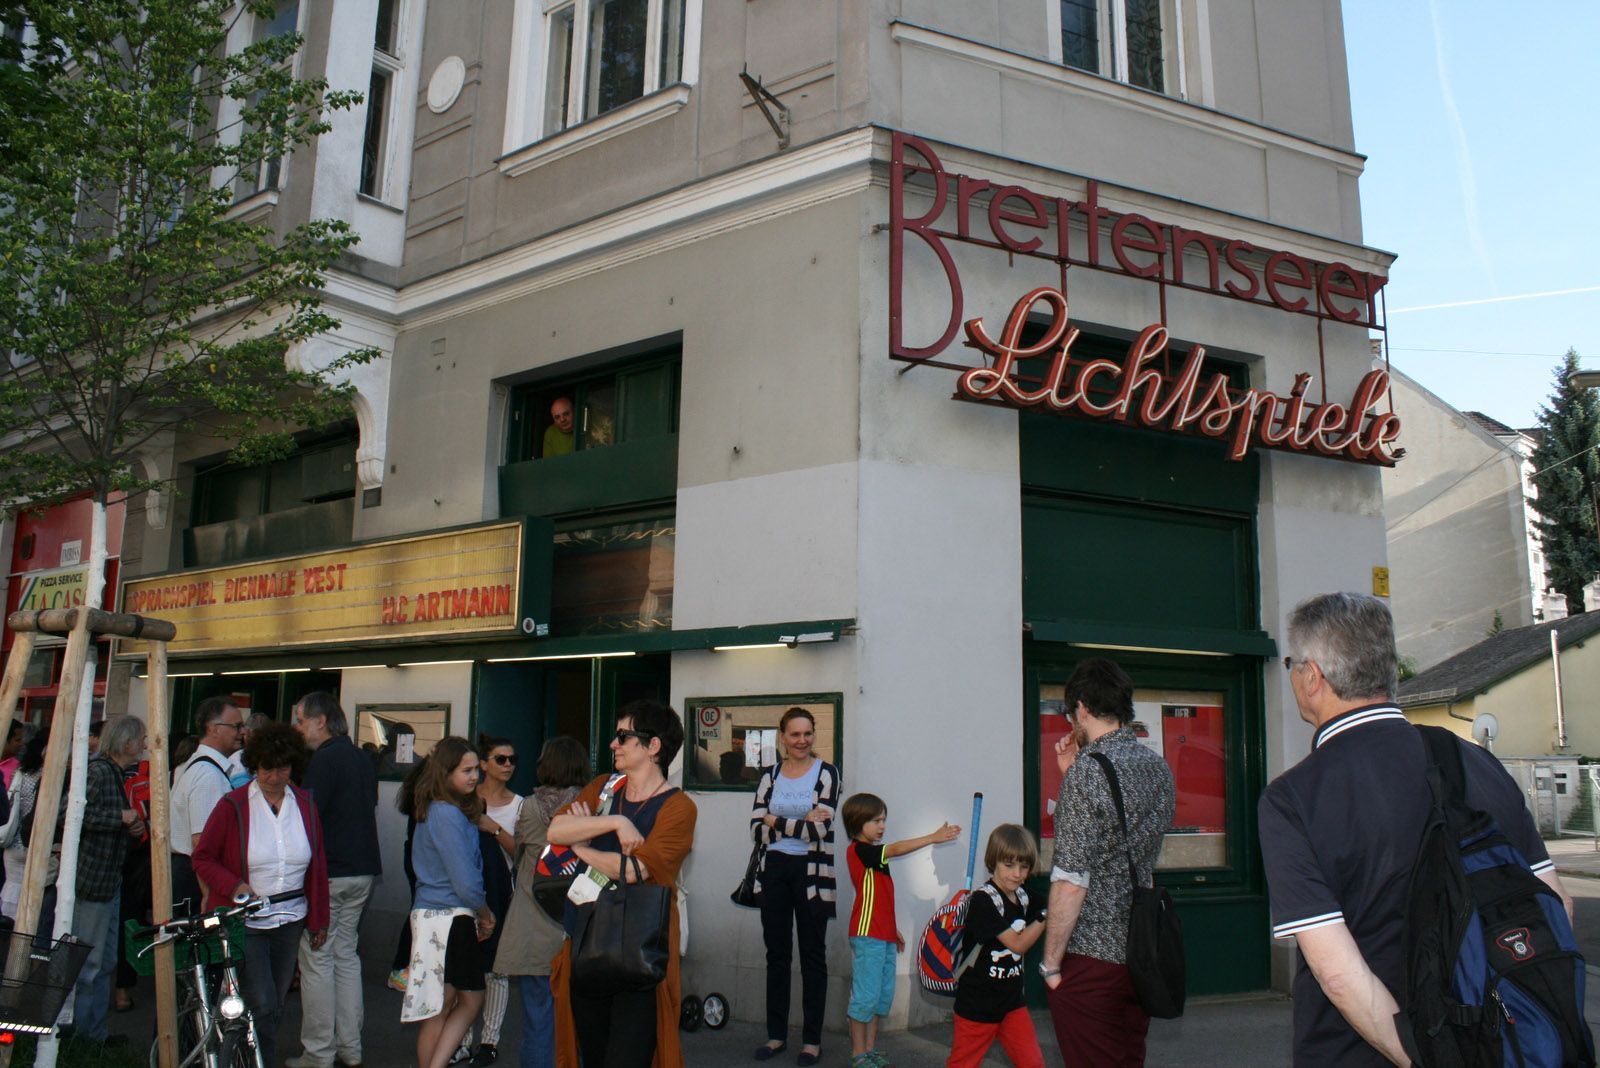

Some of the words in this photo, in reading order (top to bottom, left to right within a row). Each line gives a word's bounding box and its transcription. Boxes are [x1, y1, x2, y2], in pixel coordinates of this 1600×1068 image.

[889, 130, 1389, 359] Breitenseer
[956, 286, 1407, 462] Lichtspiele
[40, 576, 57, 588] PIZZA
[58, 572, 83, 586] SERVICE
[52, 587, 87, 610] CAS
[131, 579, 217, 613] SPRACHSPIEL
[223, 569, 297, 604] BIENNALE
[303, 562, 348, 594] WEST
[381, 595, 409, 625] HC
[413, 583, 512, 623] ARTMANN
